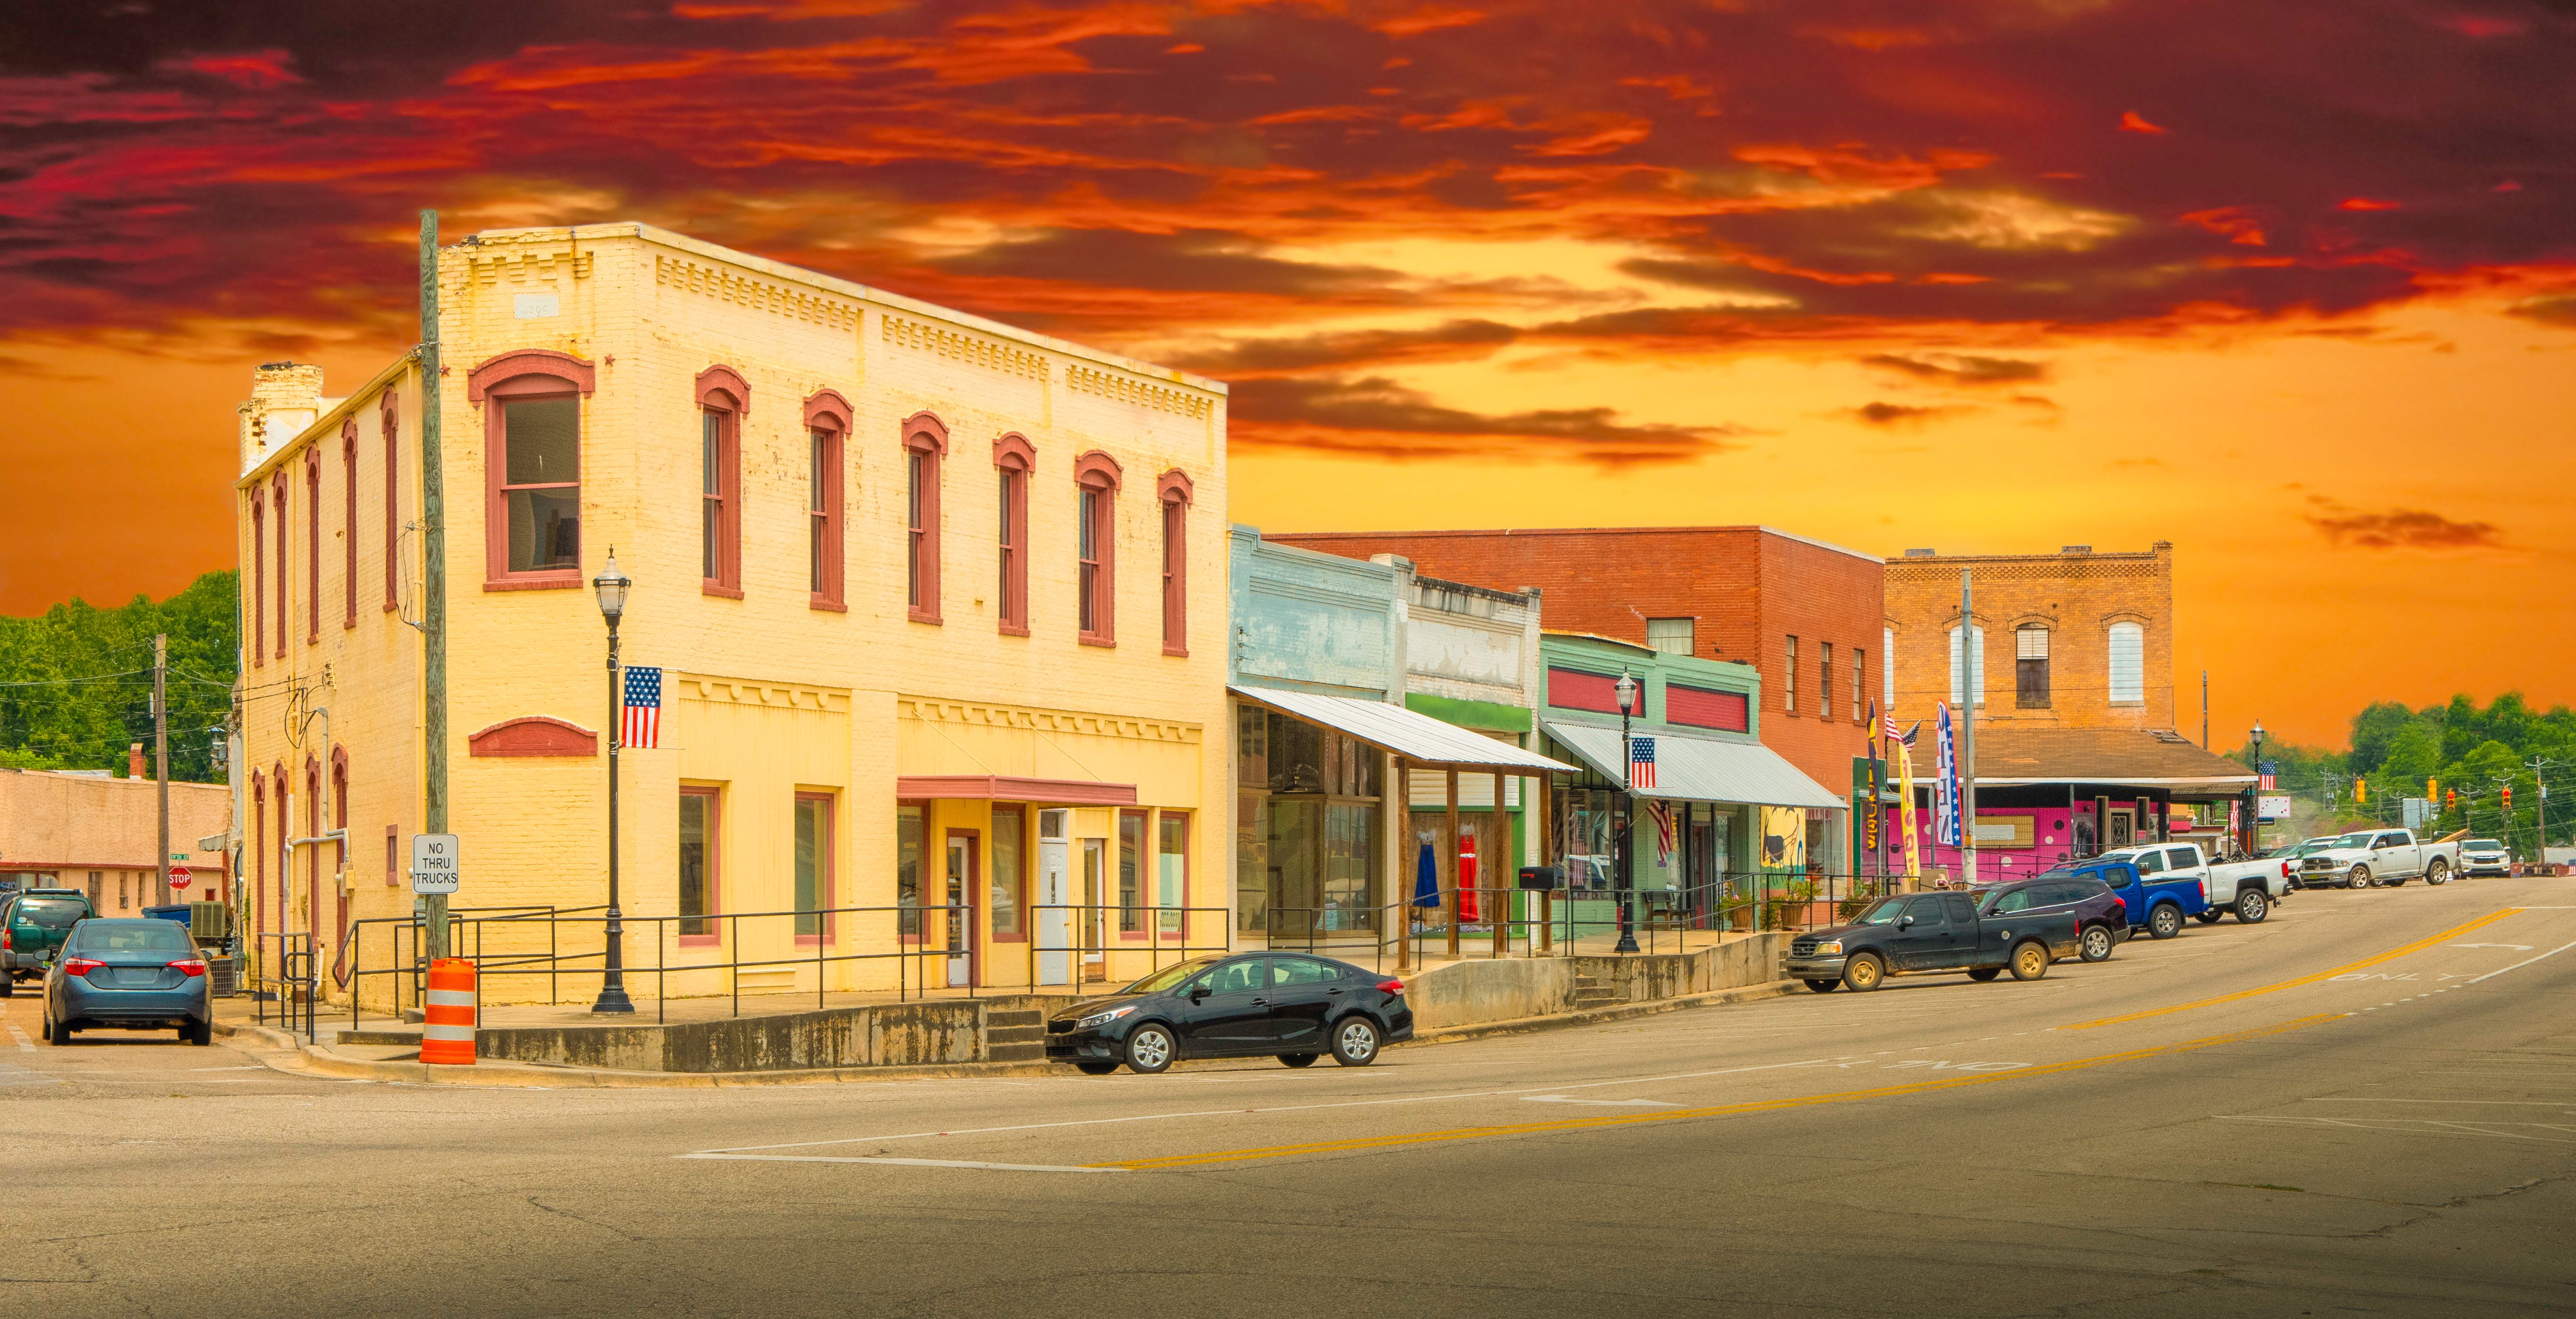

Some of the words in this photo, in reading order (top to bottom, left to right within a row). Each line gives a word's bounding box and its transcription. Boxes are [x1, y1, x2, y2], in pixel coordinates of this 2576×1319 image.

[429, 843, 443, 854] NO
[422, 857, 450, 869] THRU
[169, 874, 190, 883] STOP
[415, 872, 457, 884] TRUCKS
[2327, 973, 2478, 981] ONLY
